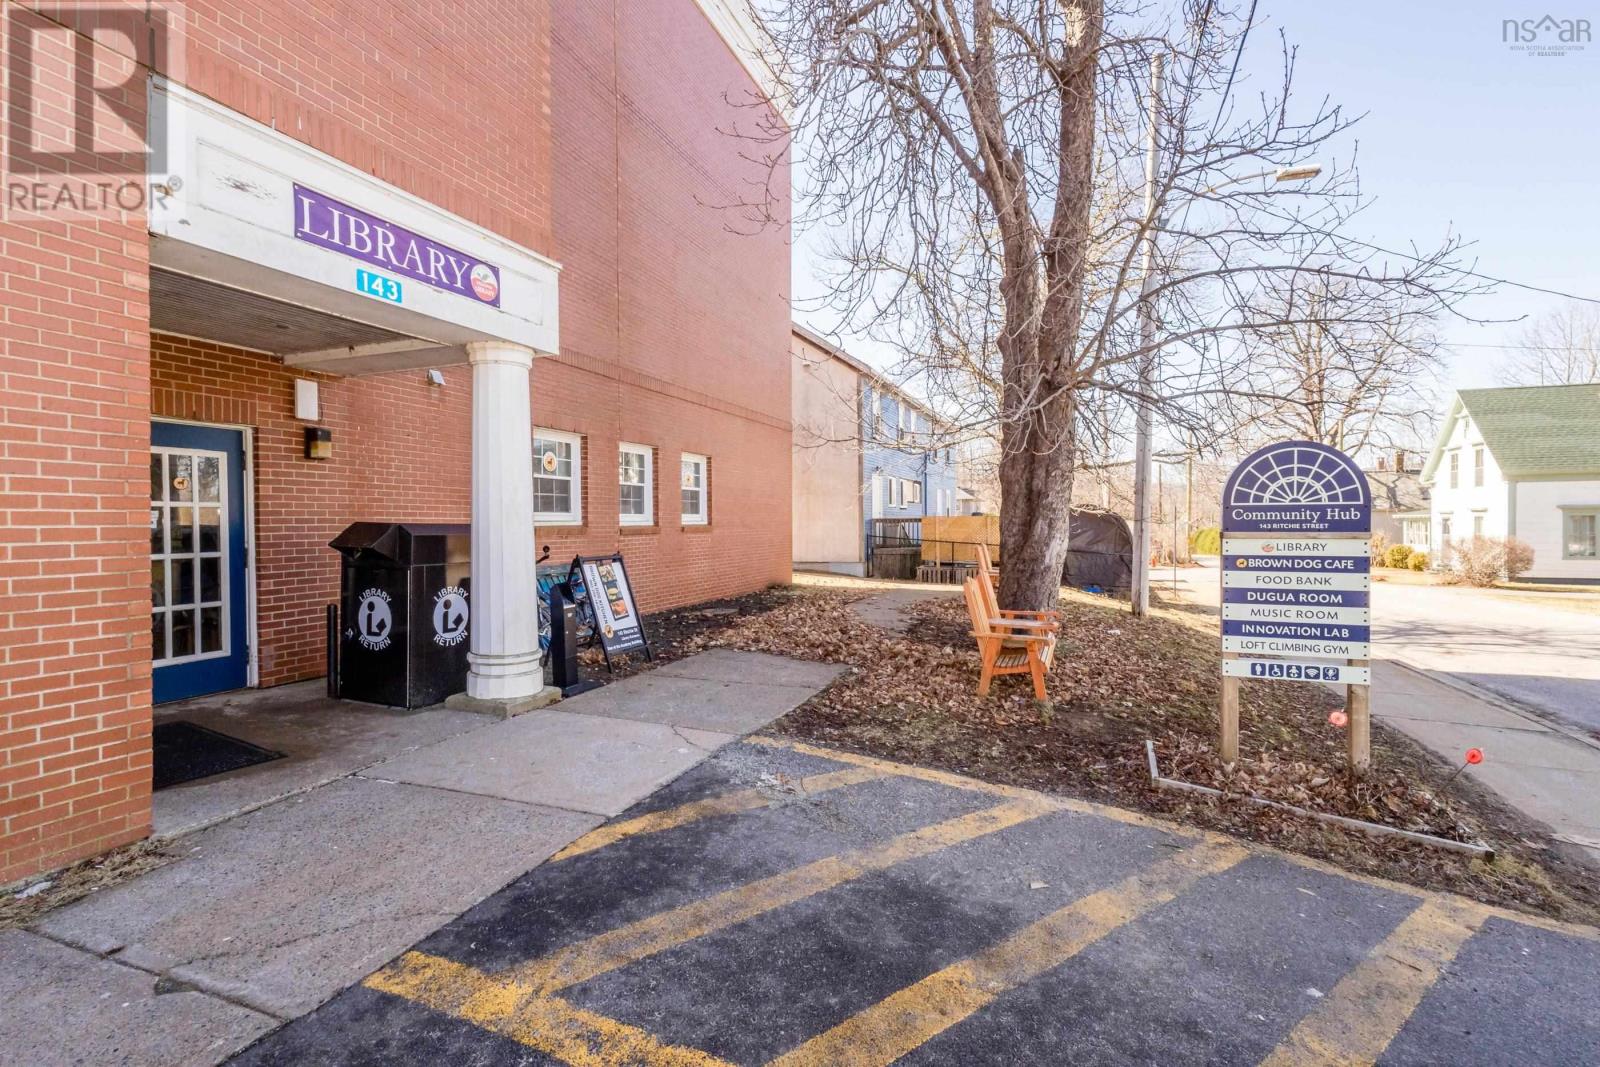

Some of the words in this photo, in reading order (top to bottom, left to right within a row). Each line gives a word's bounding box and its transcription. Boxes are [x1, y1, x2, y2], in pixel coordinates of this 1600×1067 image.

[298, 195, 470, 290] LIBRARY
[361, 272, 399, 301] 143
[1232, 508, 1321, 523] Community
[1327, 508, 1361, 521] Hub
[1276, 542, 1328, 552] LIBRARY
[1248, 558, 1294, 570] BROWN
[1294, 559, 1322, 570] DOG
[1324, 559, 1355, 570] CAFE
[1255, 575, 1292, 586] FOOD
[1296, 576, 1333, 586] BANK
[359, 587, 392, 604] LIBRARY
[433, 585, 469, 602] LIBRARY
[1247, 591, 1295, 603] DUGUA
[1300, 592, 1343, 604] ROOM
[1250, 608, 1292, 619] MUSIC
[1297, 610, 1339, 620] ROOM
[1242, 624, 1321, 637] INNOVATION
[1324, 627, 1350, 638] LAB
[358, 635, 392, 651] RETURN
[433, 630, 469, 647] RETURN
[1240, 641, 1266, 651] LOFT
[1268, 642, 1322, 653] CLIMBING
[1323, 645, 1349, 655] GYM
